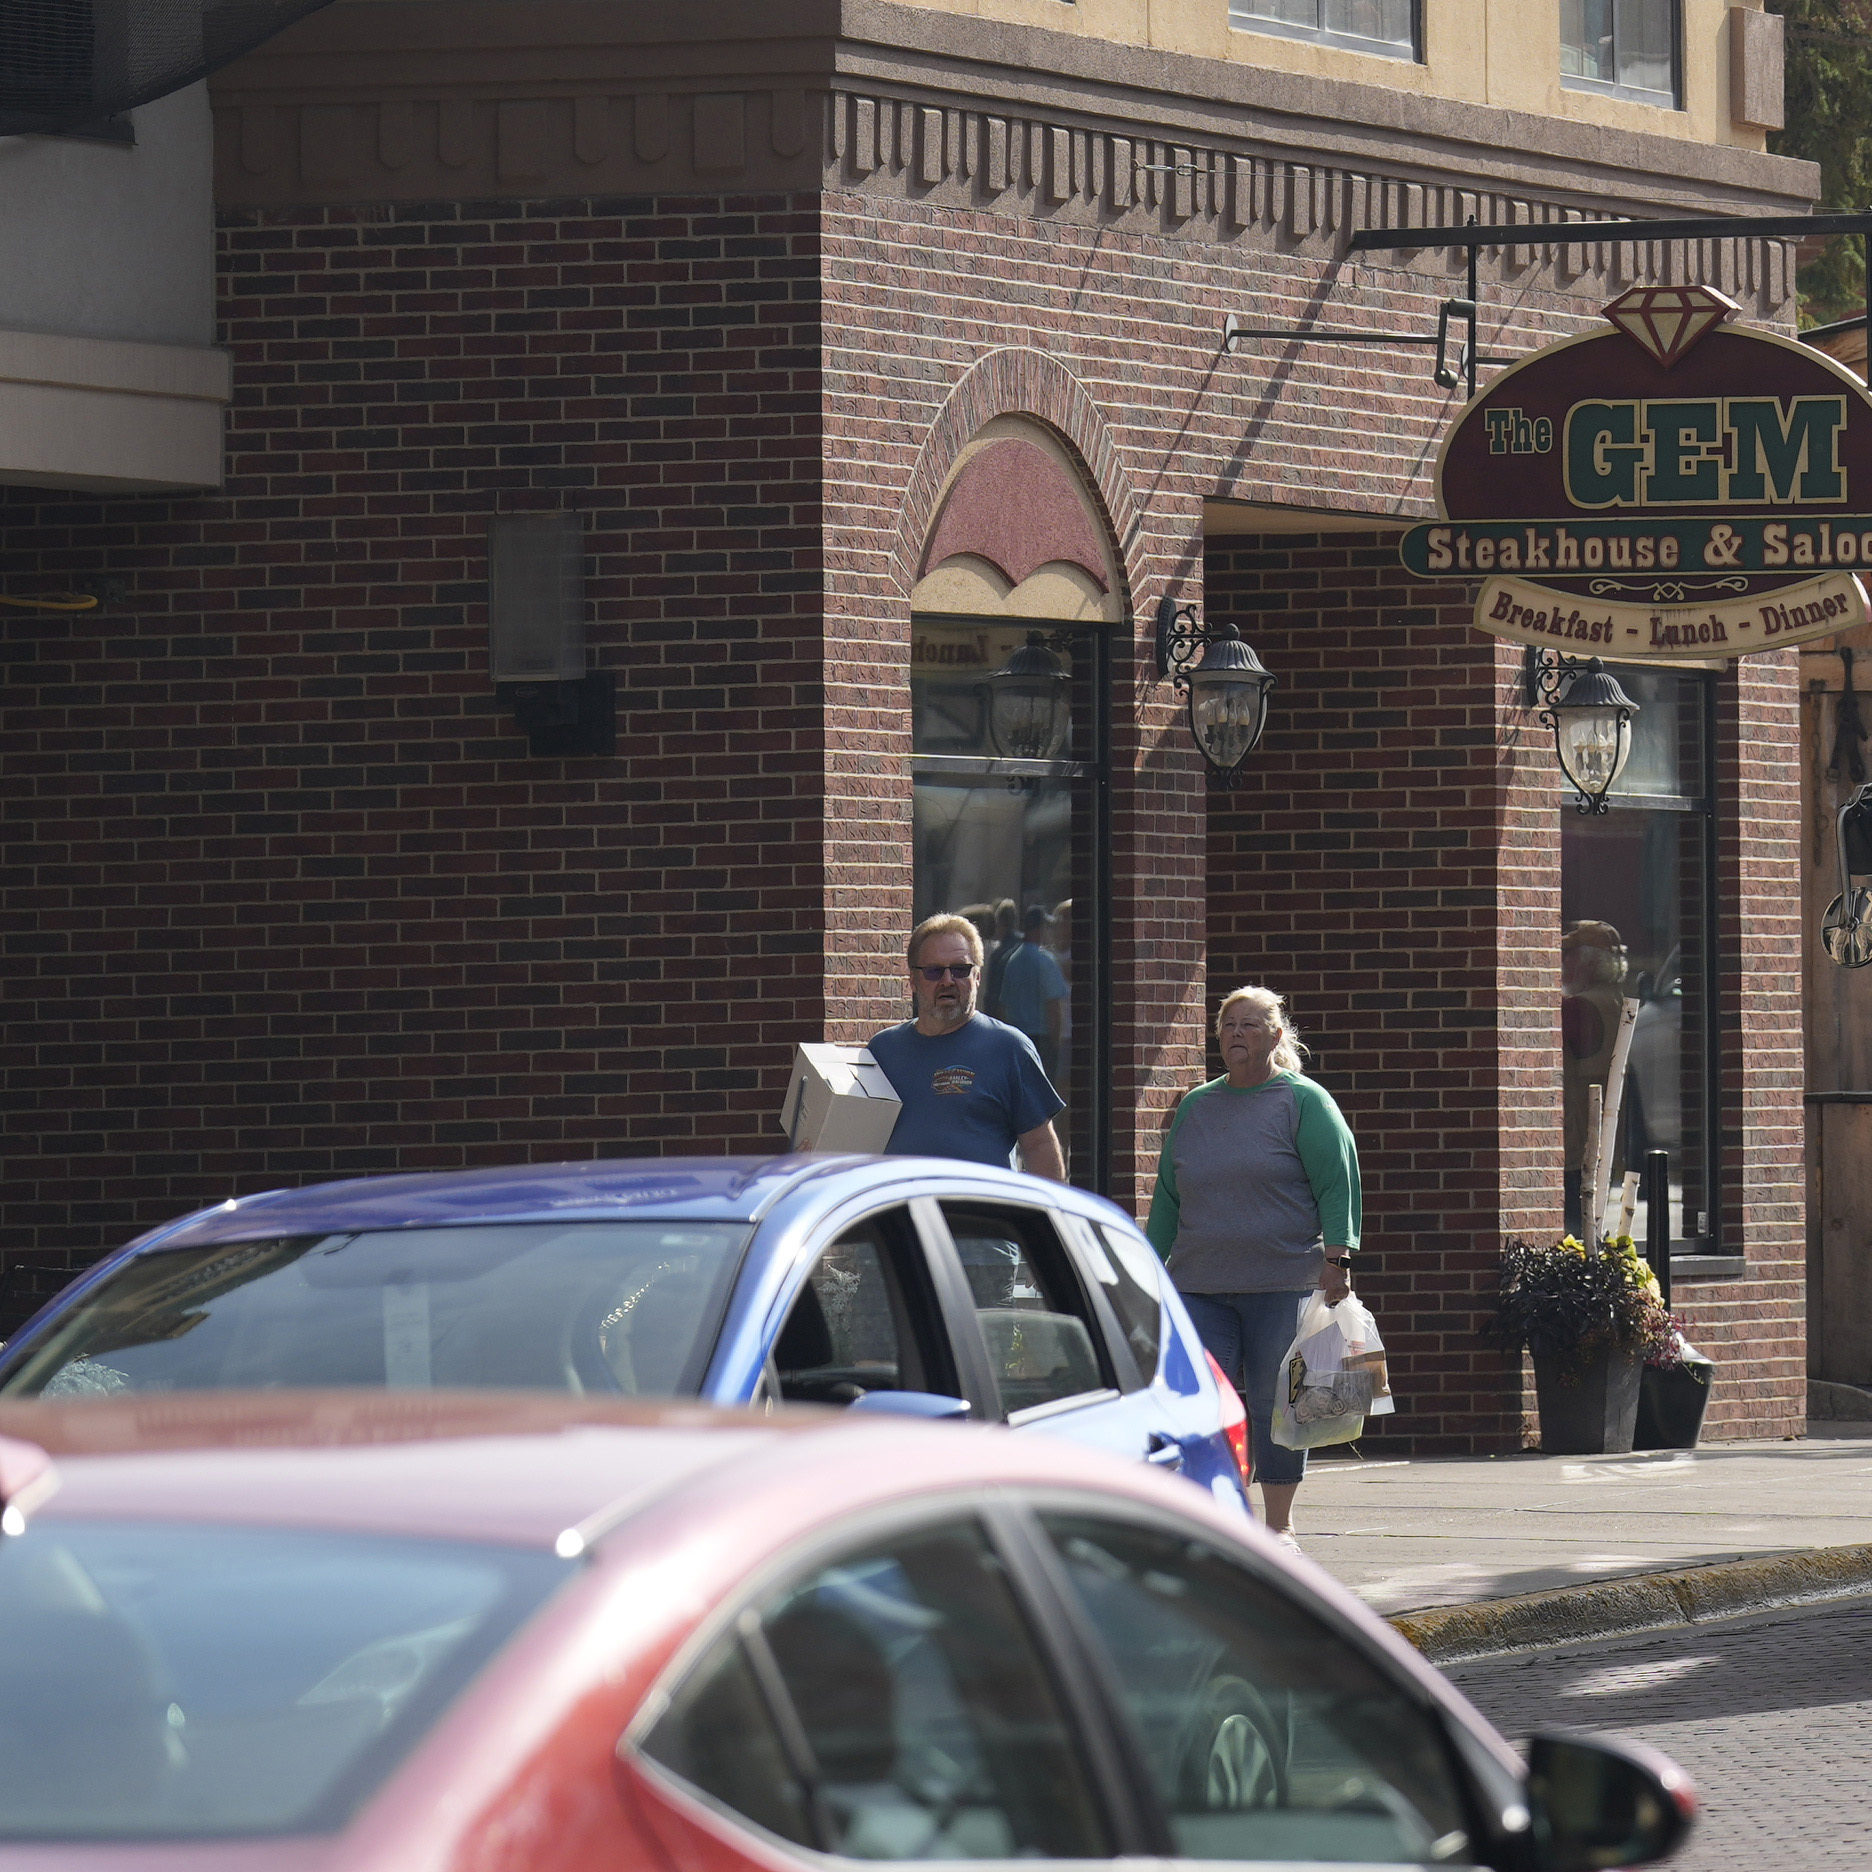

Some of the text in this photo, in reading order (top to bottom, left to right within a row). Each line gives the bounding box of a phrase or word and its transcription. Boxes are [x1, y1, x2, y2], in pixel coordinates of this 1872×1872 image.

[1485, 394, 1848, 509] The GEM
[1427, 527, 1680, 570] Steakhouse
[1703, 523, 1744, 566] &
[1489, 591, 1613, 644] Breakfast
[1650, 615, 1727, 647] Lunch
[1759, 591, 1849, 637] Dinner
